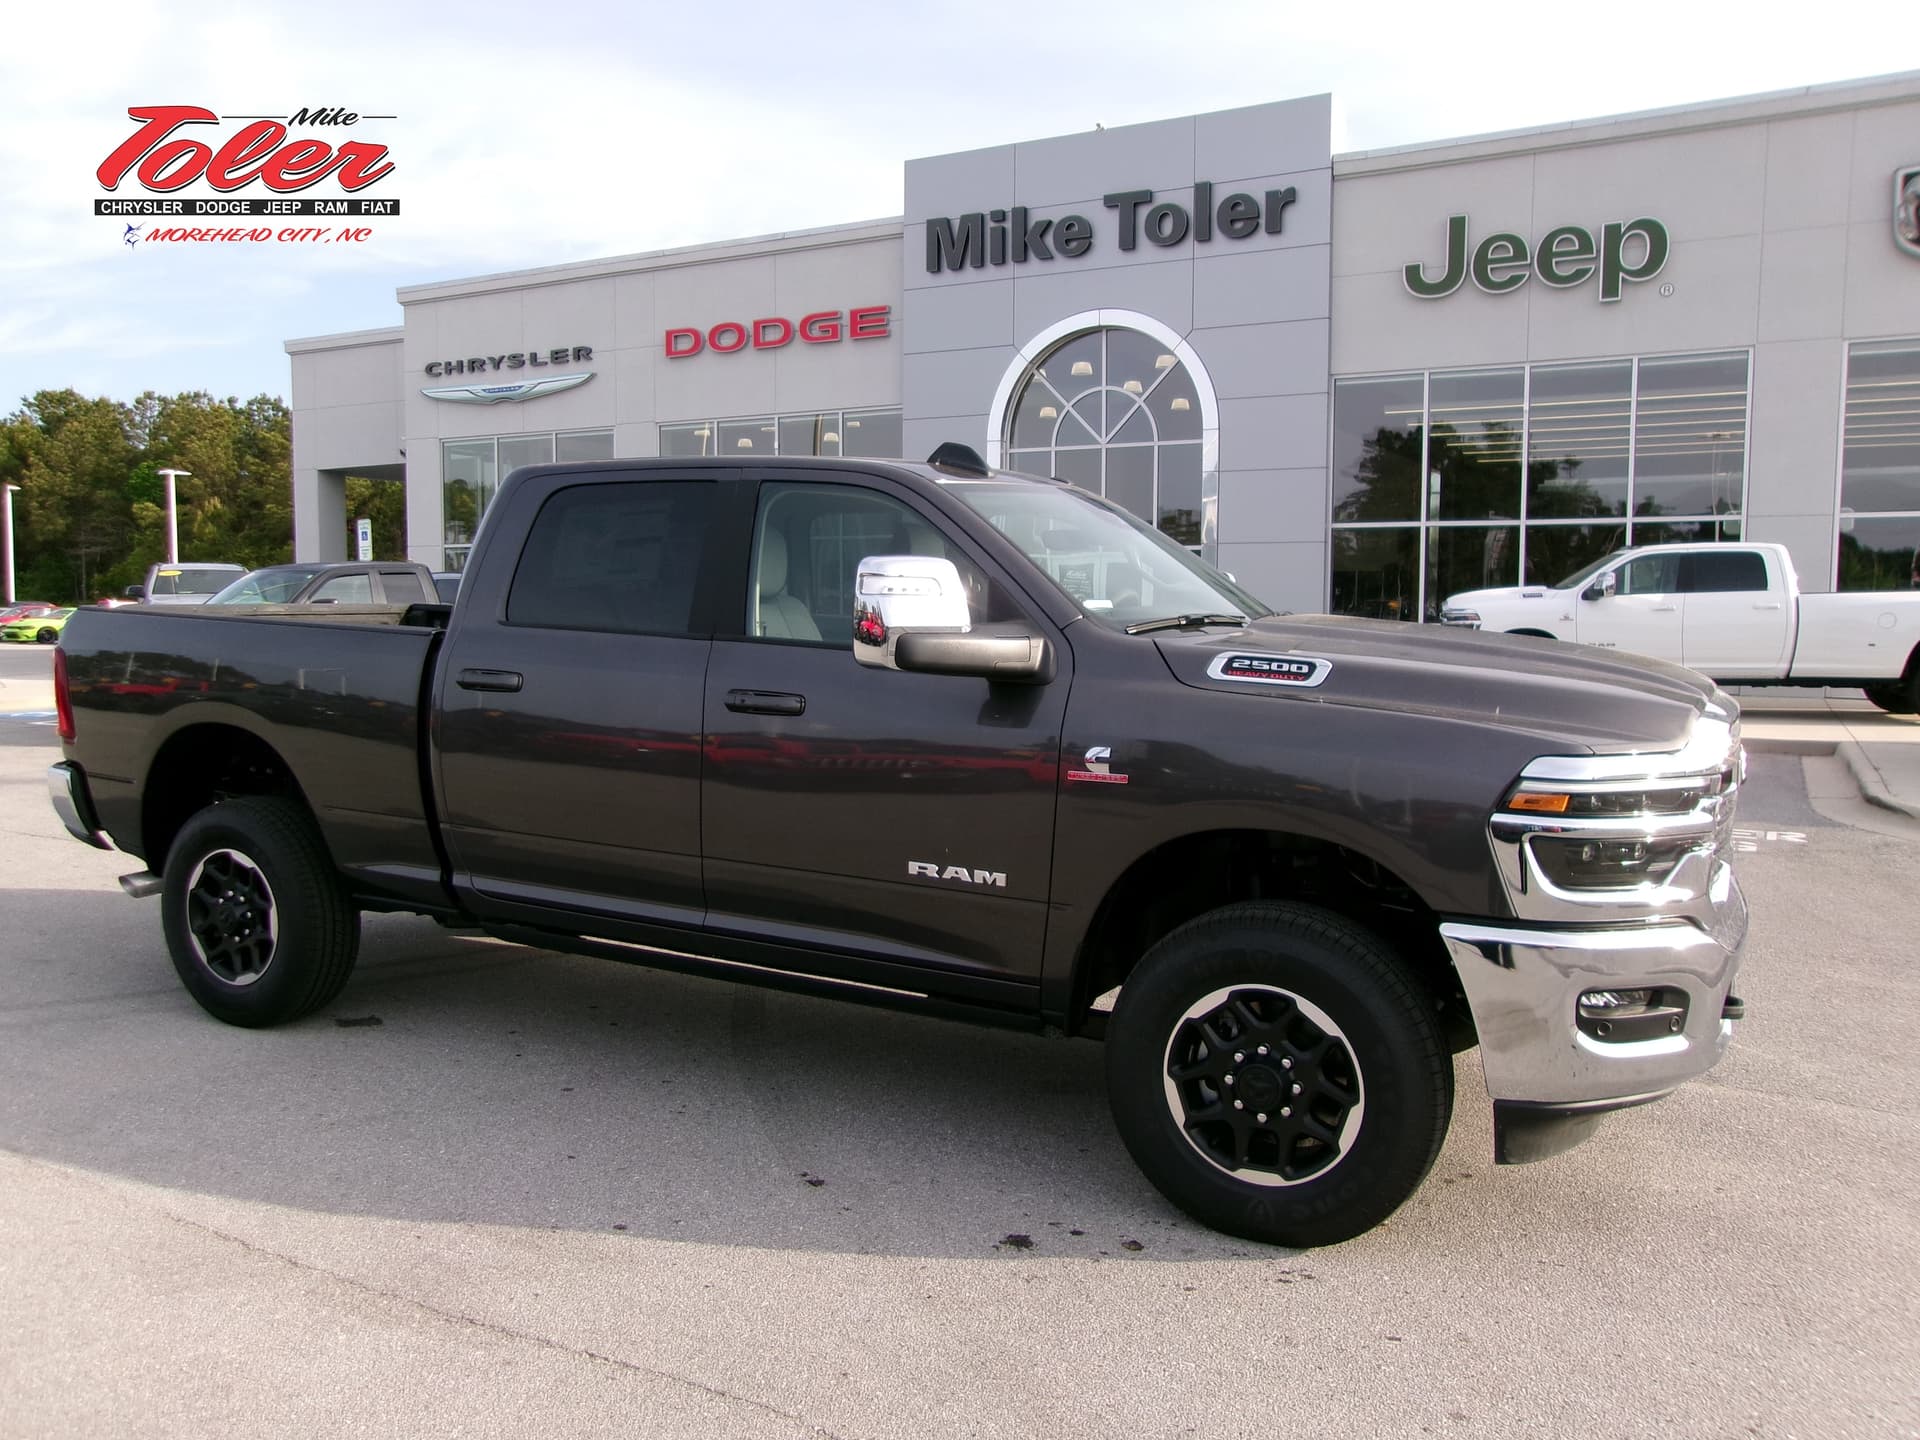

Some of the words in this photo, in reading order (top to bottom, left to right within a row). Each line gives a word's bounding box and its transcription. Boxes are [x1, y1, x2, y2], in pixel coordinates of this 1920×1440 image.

[926, 206, 1093, 273] Mike
[1103, 181, 1297, 251] Toler
[1403, 215, 1670, 302] Jeep
[665, 305, 892, 360] DODGE
[425, 346, 594, 377] CHRYSLER
[1227, 670, 1268, 679] HEAVY
[1270, 673, 1306, 681] DUTY
[1231, 658, 1310, 673] 2500
[908, 861, 1008, 887] RAM
